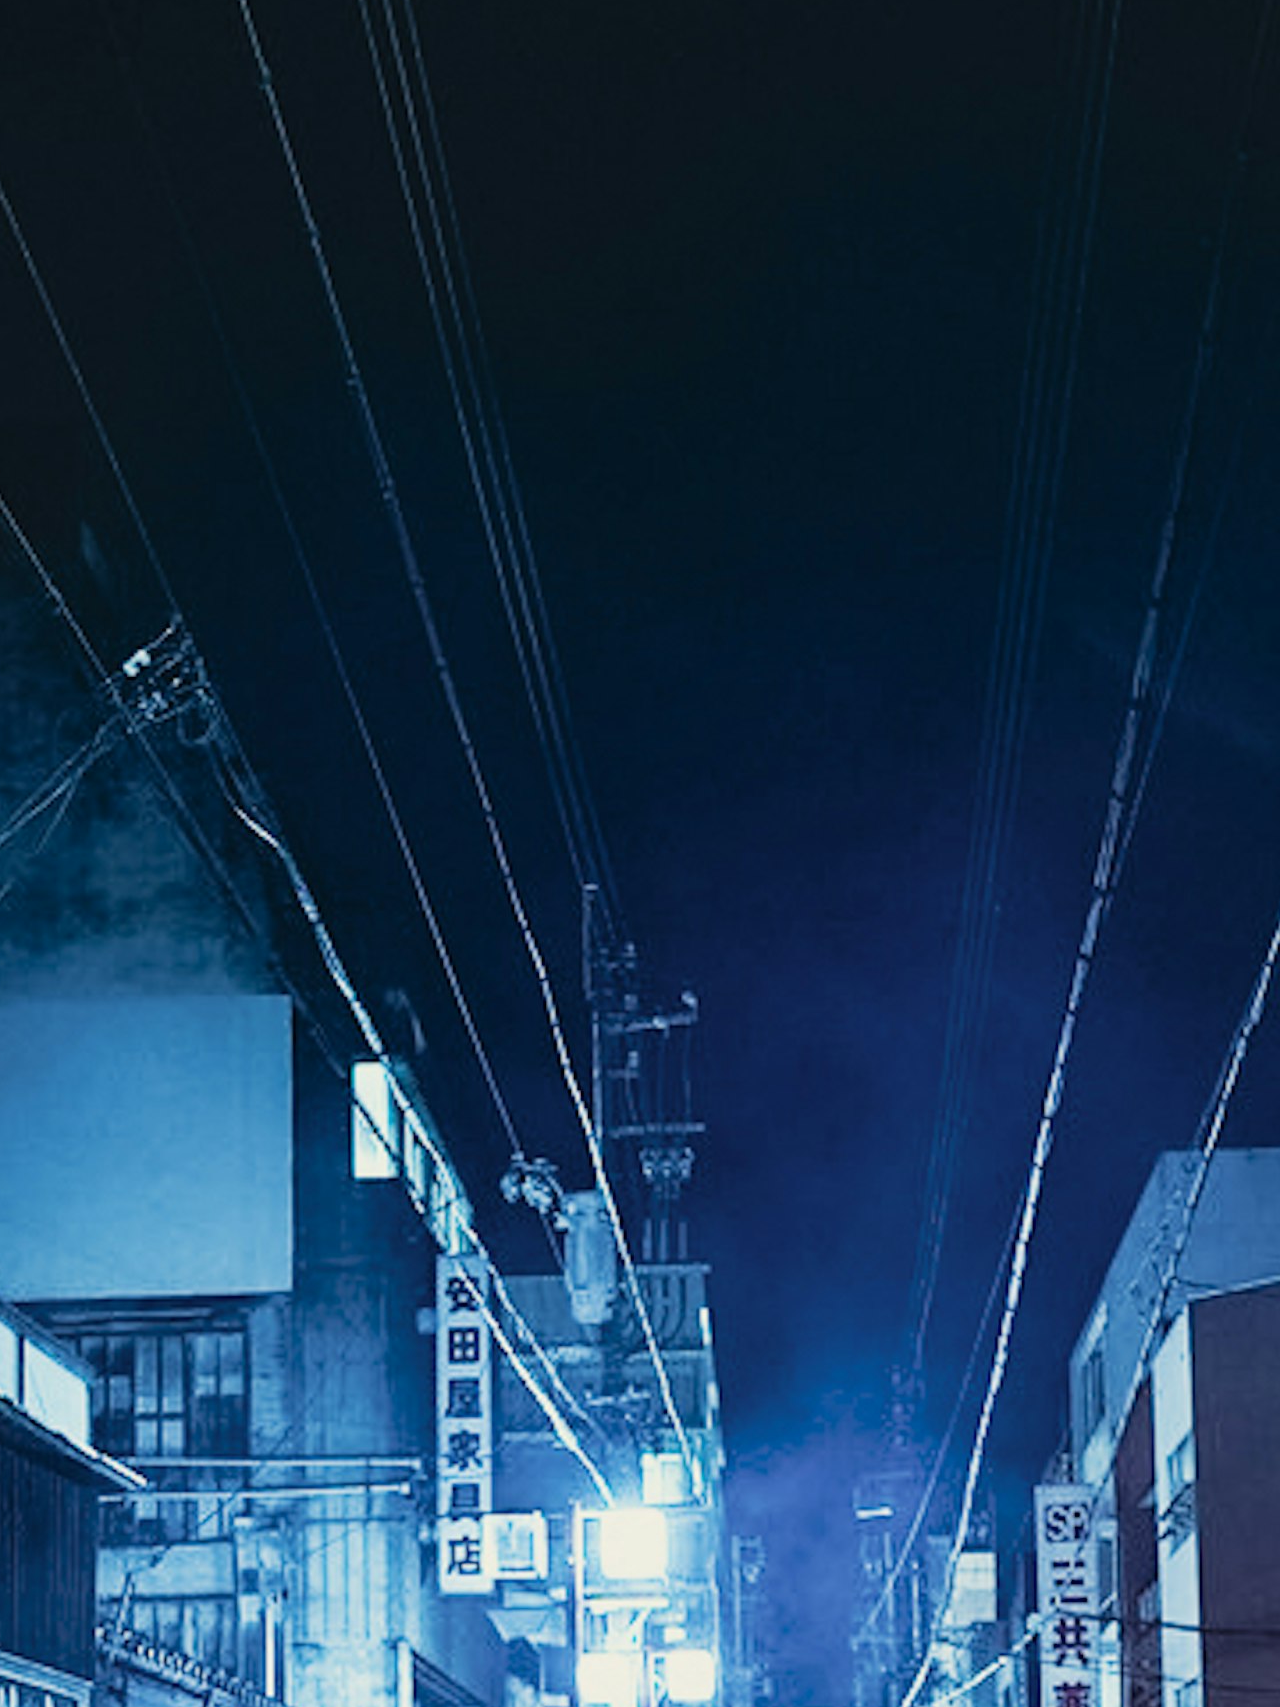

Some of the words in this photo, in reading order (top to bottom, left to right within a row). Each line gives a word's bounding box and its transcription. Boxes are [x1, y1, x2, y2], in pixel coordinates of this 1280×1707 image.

[445, 1276, 483, 1577] 安田屋家具店
